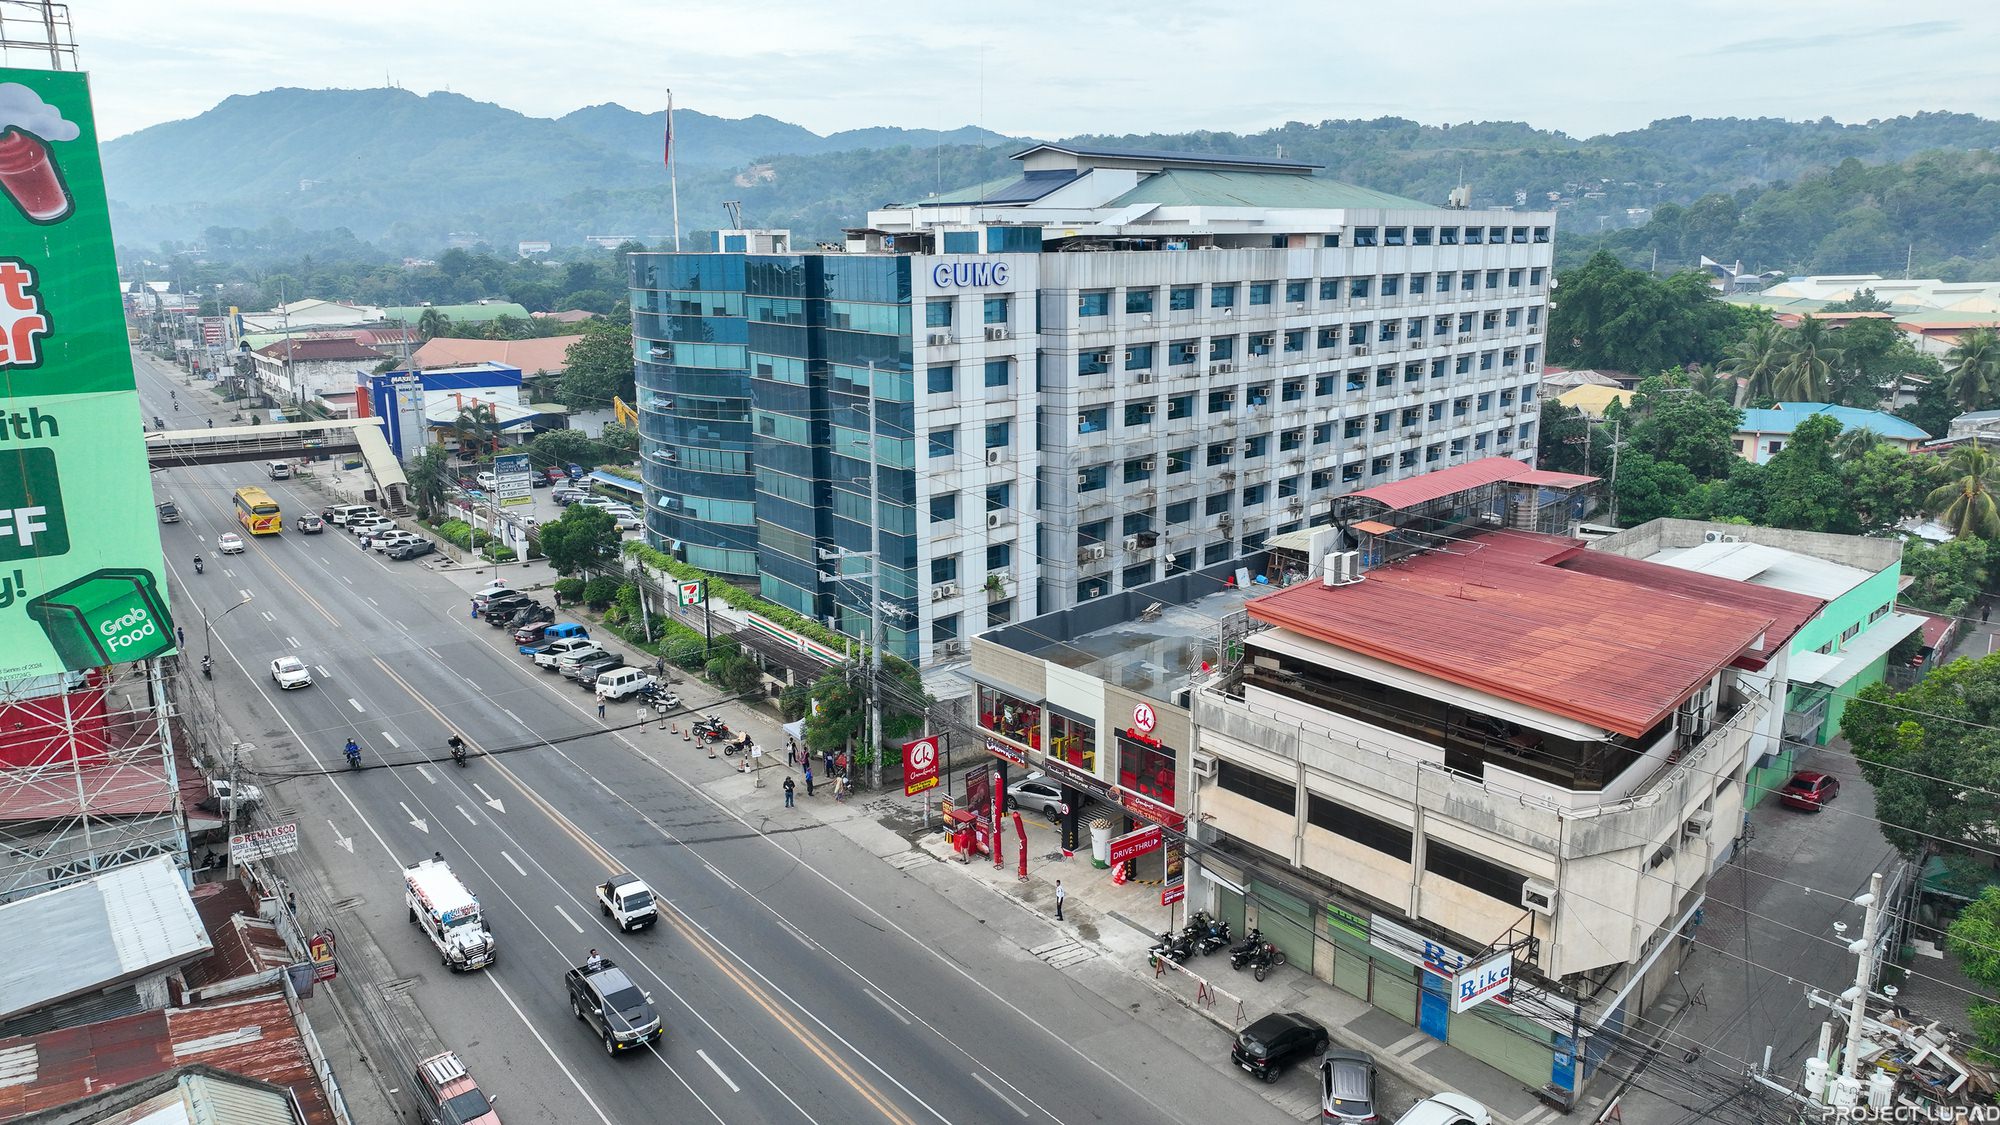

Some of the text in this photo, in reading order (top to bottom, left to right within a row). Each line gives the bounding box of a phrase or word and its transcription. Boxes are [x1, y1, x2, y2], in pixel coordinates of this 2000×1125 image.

[933, 262, 1009, 288] CUMC
[100, 608, 146, 636] Grab
[107, 619, 155, 652] Food
[244, 824, 296, 843] REMARSCO
[1113, 840, 1153, 860] DRIVE-THRU
[1459, 966, 1510, 999] Rika
